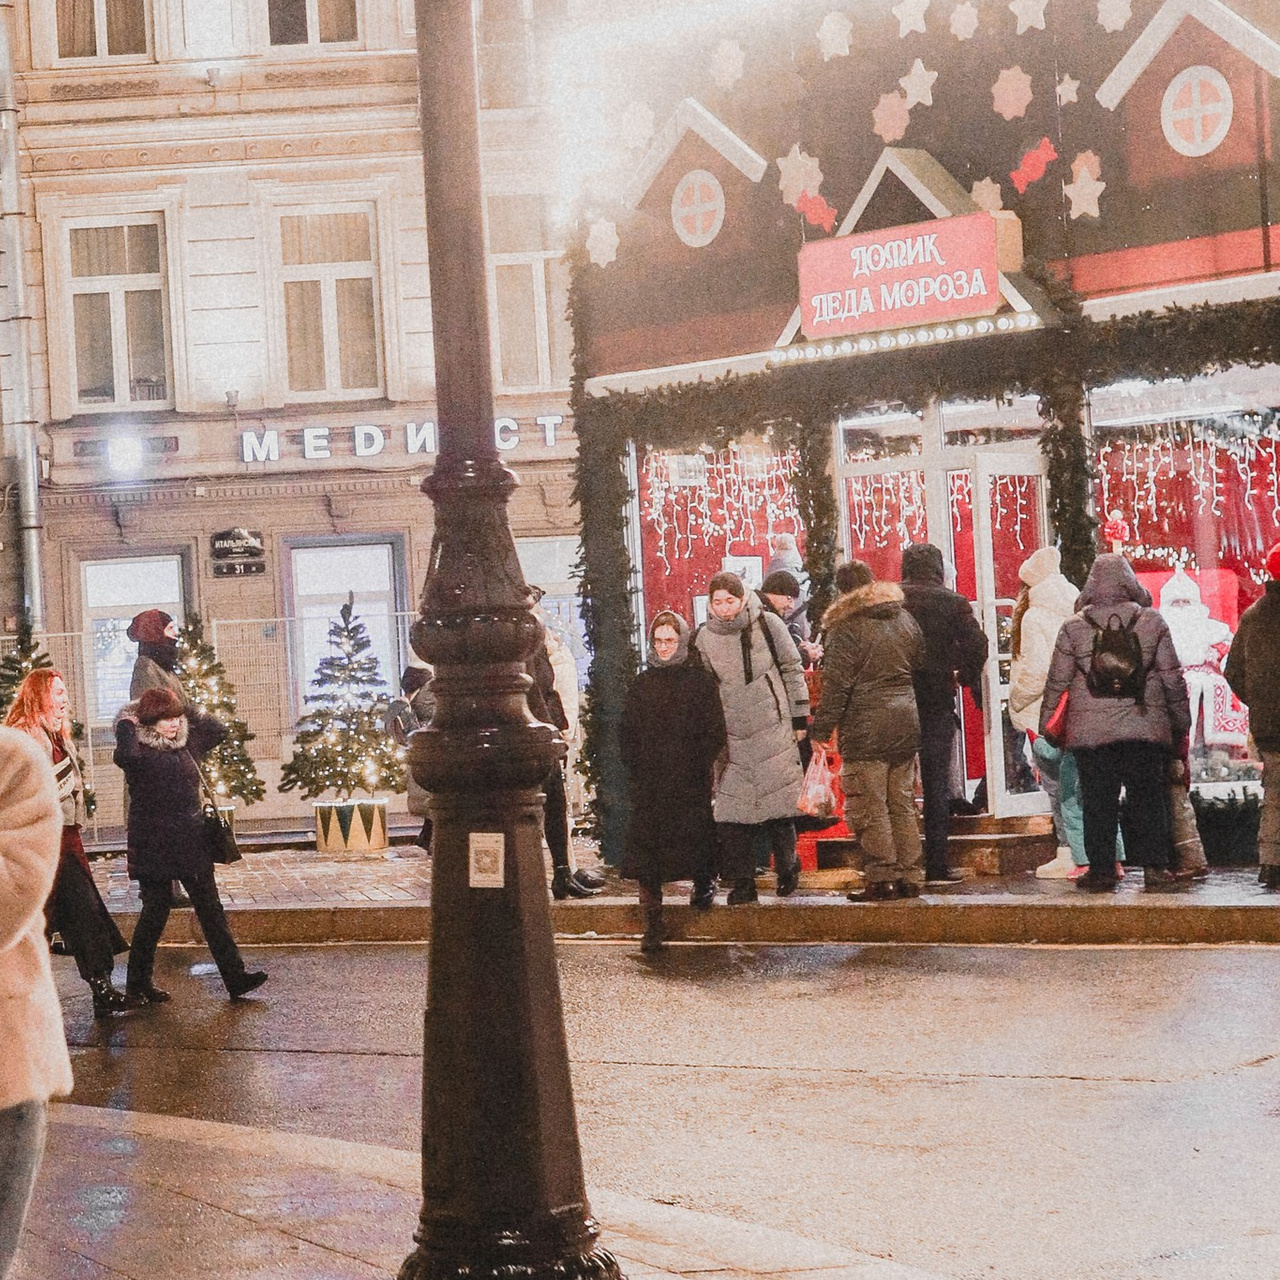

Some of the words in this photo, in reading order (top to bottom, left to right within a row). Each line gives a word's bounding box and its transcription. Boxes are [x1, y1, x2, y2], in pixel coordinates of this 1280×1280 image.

[850, 233, 947, 279] ДОМИК
[811, 287, 876, 326] ДЕДА
[880, 268, 988, 312] МОРОЗА
[234, 564, 245, 574] 31
